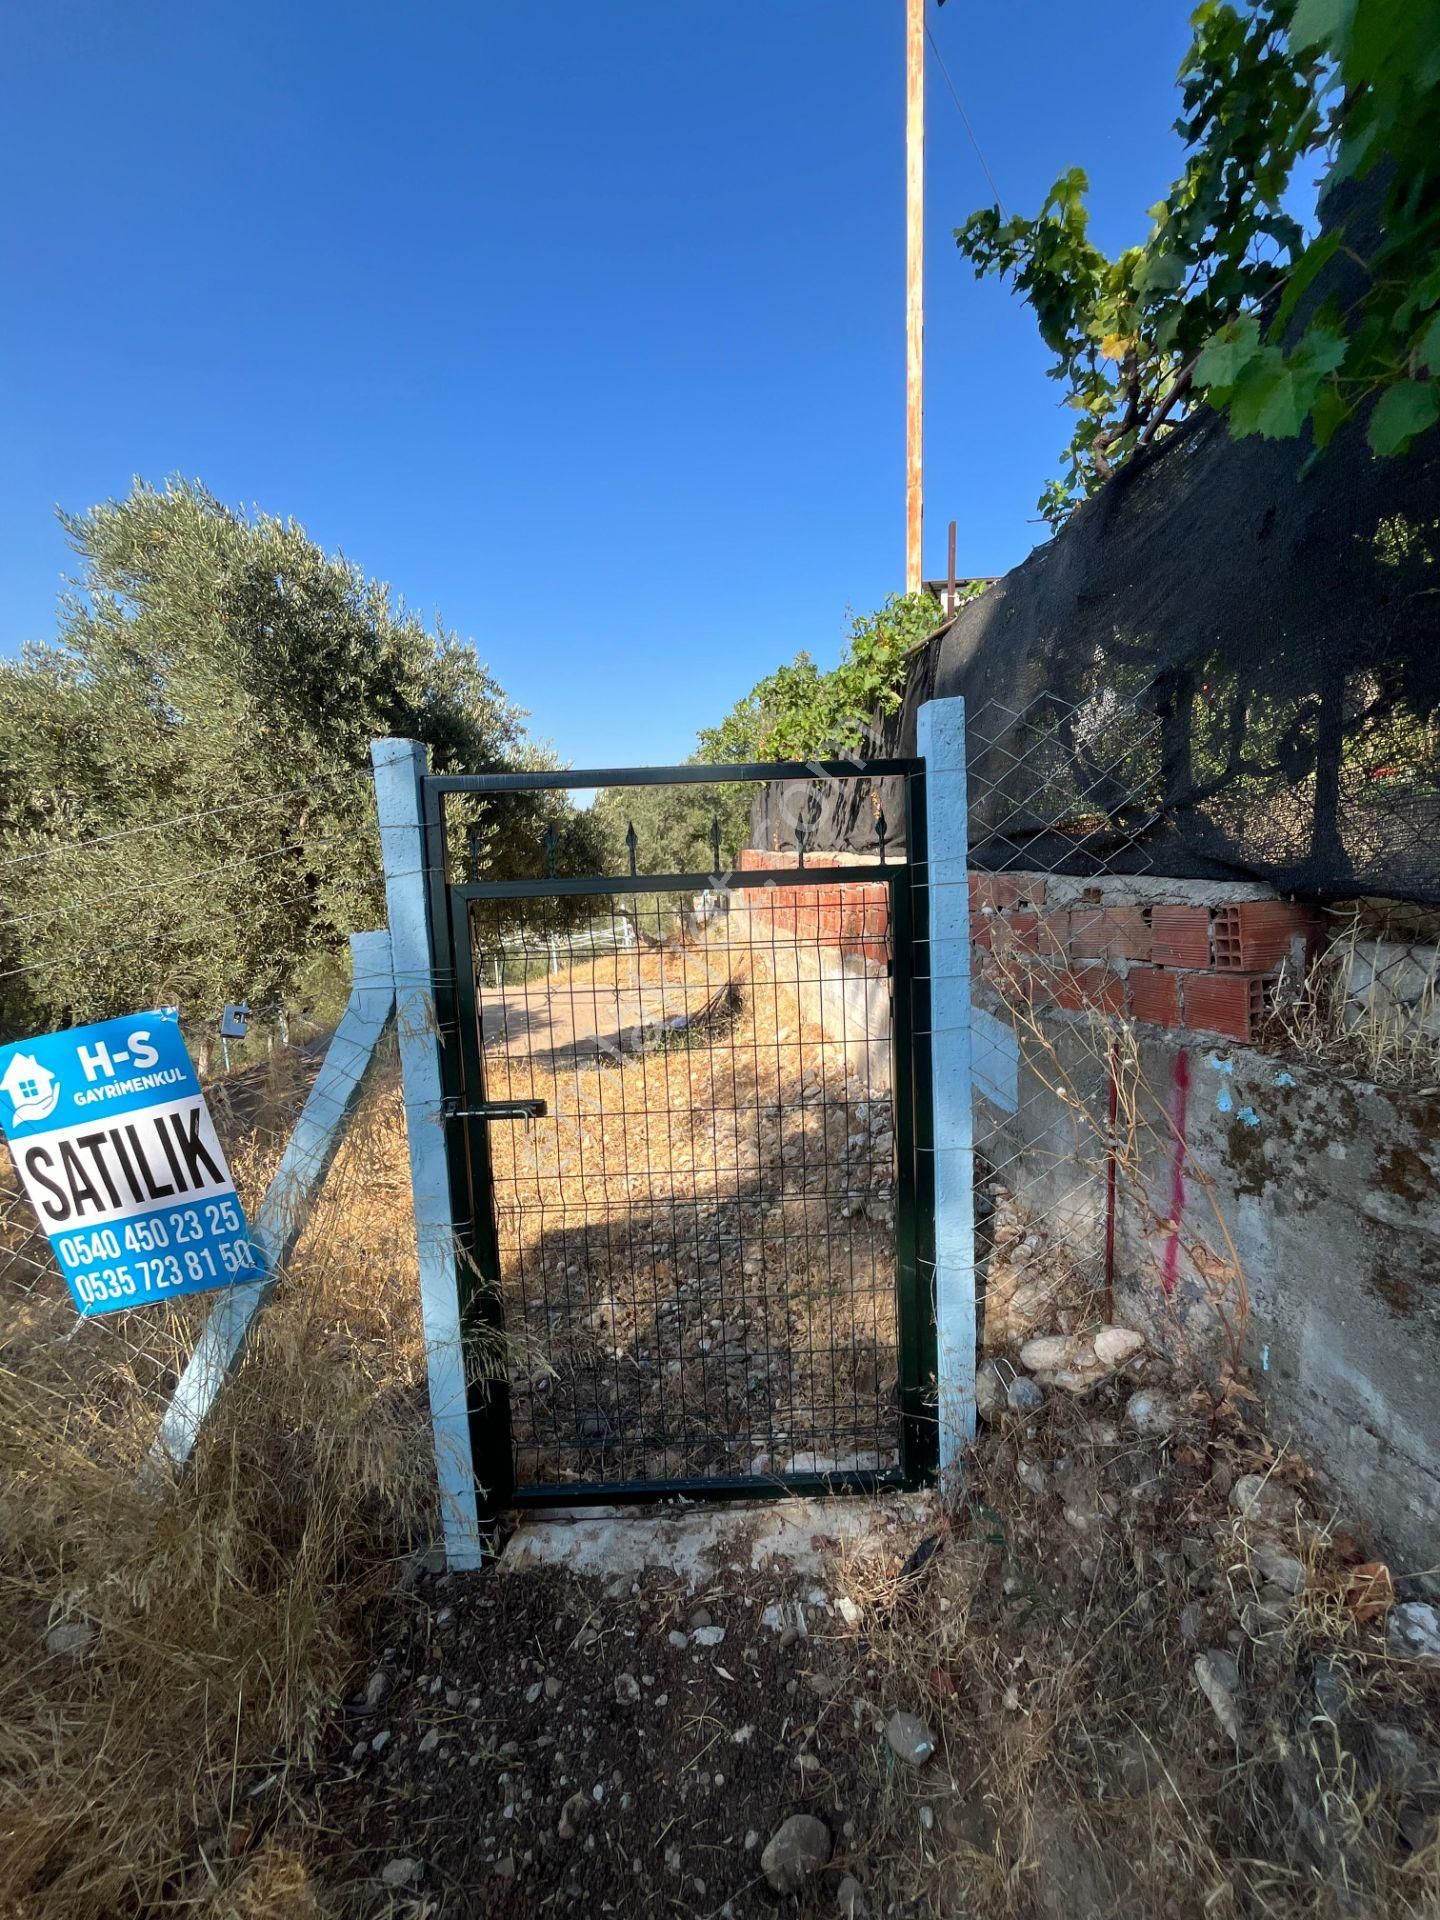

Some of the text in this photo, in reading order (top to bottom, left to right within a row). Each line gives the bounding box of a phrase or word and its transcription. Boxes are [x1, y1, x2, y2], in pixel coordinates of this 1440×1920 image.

[74, 1067, 187, 1106] GAYRİMENKUL
[76, 1031, 159, 1082] H-S
[25, 1108, 226, 1222] SATILIK
[60, 1201, 239, 1268] 0540 450 23 25
[75, 1239, 253, 1303] 0535 723 81 50
